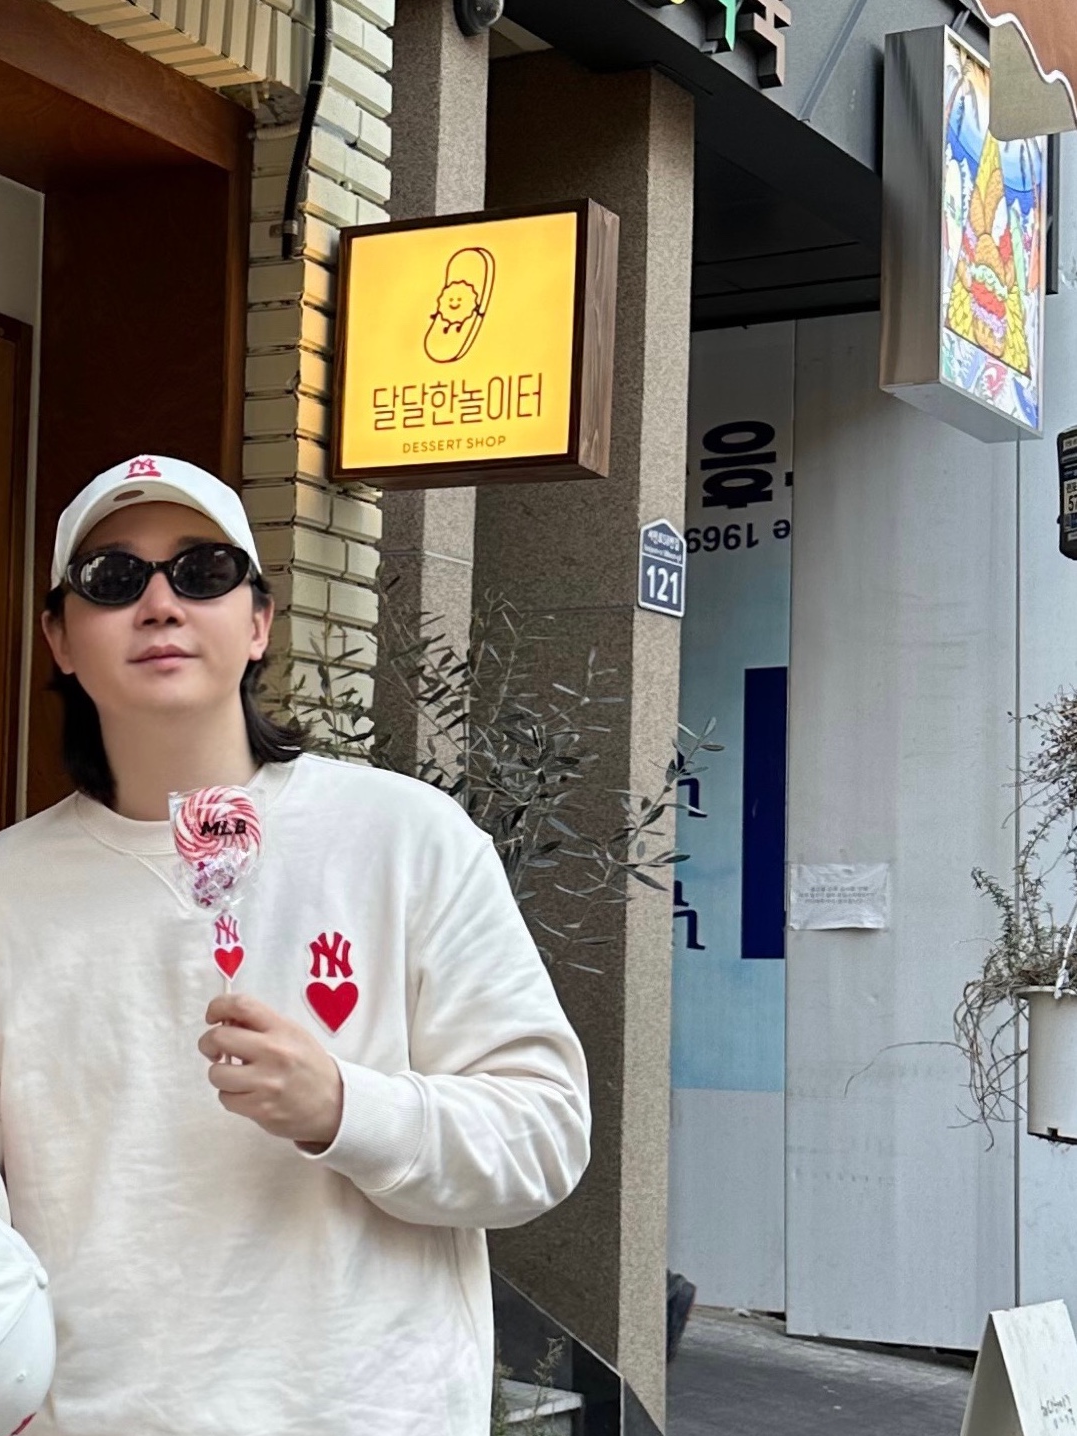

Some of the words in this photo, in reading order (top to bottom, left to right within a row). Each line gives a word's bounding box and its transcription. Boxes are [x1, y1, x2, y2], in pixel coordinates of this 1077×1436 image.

[373, 372, 543, 431] 달달한놀이터
[402, 438, 463, 454] DESSERT
[466, 435, 507, 450] SHOP
[684, 522, 760, 554] 1969
[646, 565, 679, 605] 121
[200, 818, 248, 838] MLB
[309, 930, 354, 979] NY
